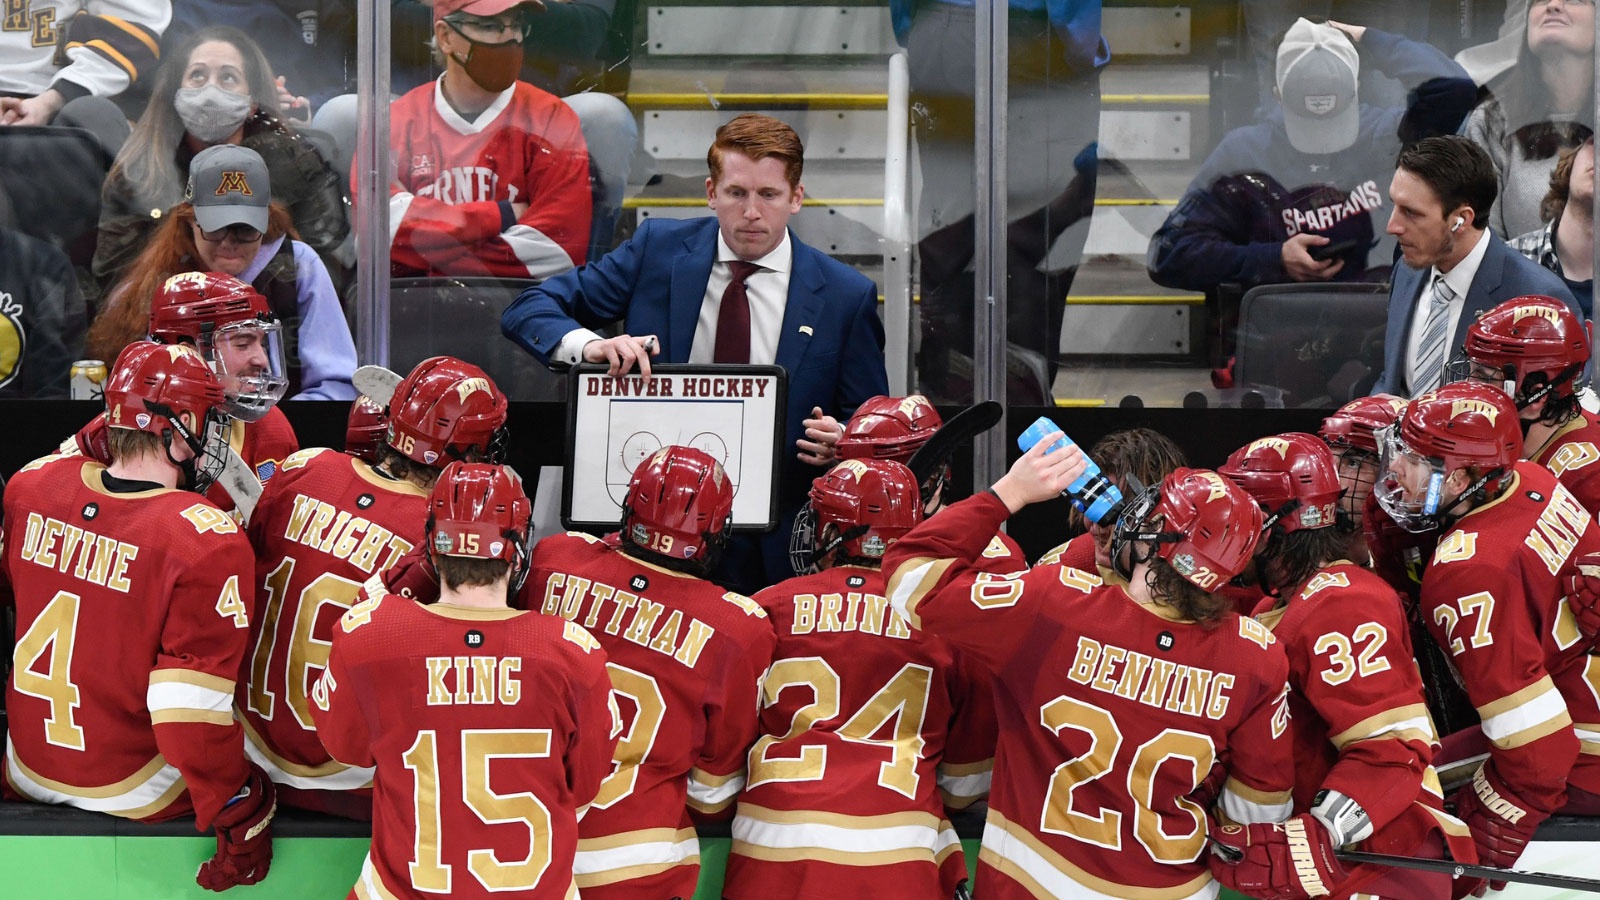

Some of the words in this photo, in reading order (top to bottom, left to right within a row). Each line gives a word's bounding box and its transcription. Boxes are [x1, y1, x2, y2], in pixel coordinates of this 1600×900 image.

[215, 171, 253, 196] M
[1281, 180, 1383, 237] SPARTANS
[586, 377, 673, 397] DENVER
[682, 378, 770, 398] HOCKEY
[396, 431, 416, 455] 16
[21, 512, 139, 593] DEVINE
[284, 493, 414, 575] WRIGHT
[458, 533, 480, 554] 15
[650, 531, 674, 553] 19
[215, 575, 249, 629] 4
[1190, 566, 1219, 588] 20
[467, 633, 481, 644] RB
[541, 572, 715, 669] GUTTMAN
[1159, 635, 1173, 648] RB
[1433, 591, 1495, 656] 27
[13, 590, 85, 751] 4
[426, 656, 522, 705] KING
[1067, 636, 1235, 720] BENNING
[1314, 622, 1392, 686] 32
[746, 656, 933, 800] 24
[1040, 695, 1216, 864] 20
[402, 729, 552, 894] 15
